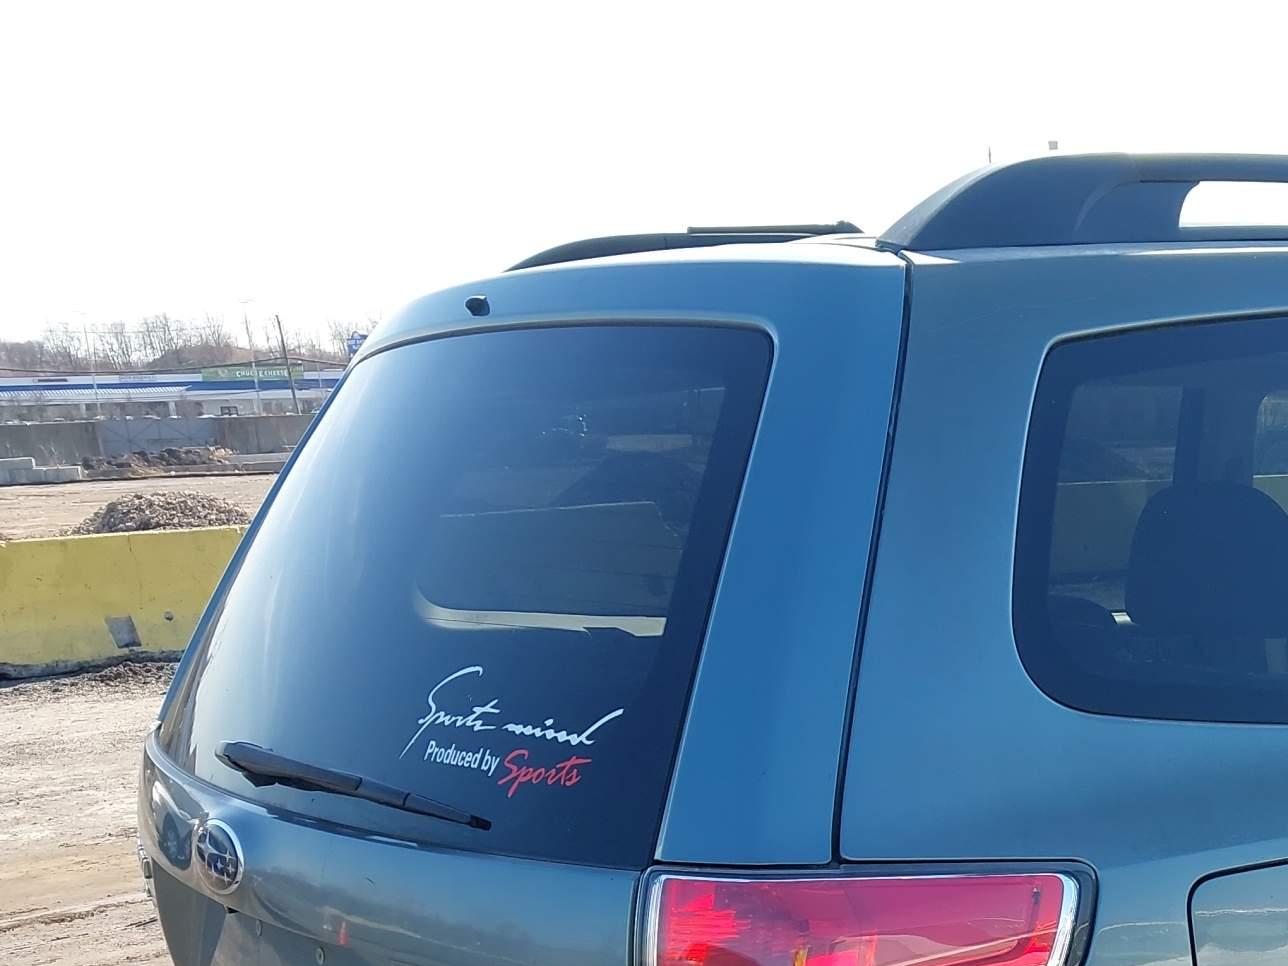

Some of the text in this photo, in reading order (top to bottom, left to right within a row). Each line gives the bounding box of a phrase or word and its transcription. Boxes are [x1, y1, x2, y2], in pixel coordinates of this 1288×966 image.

[502, 709, 624, 746] mind
[424, 740, 592, 798] Produced by Sports
